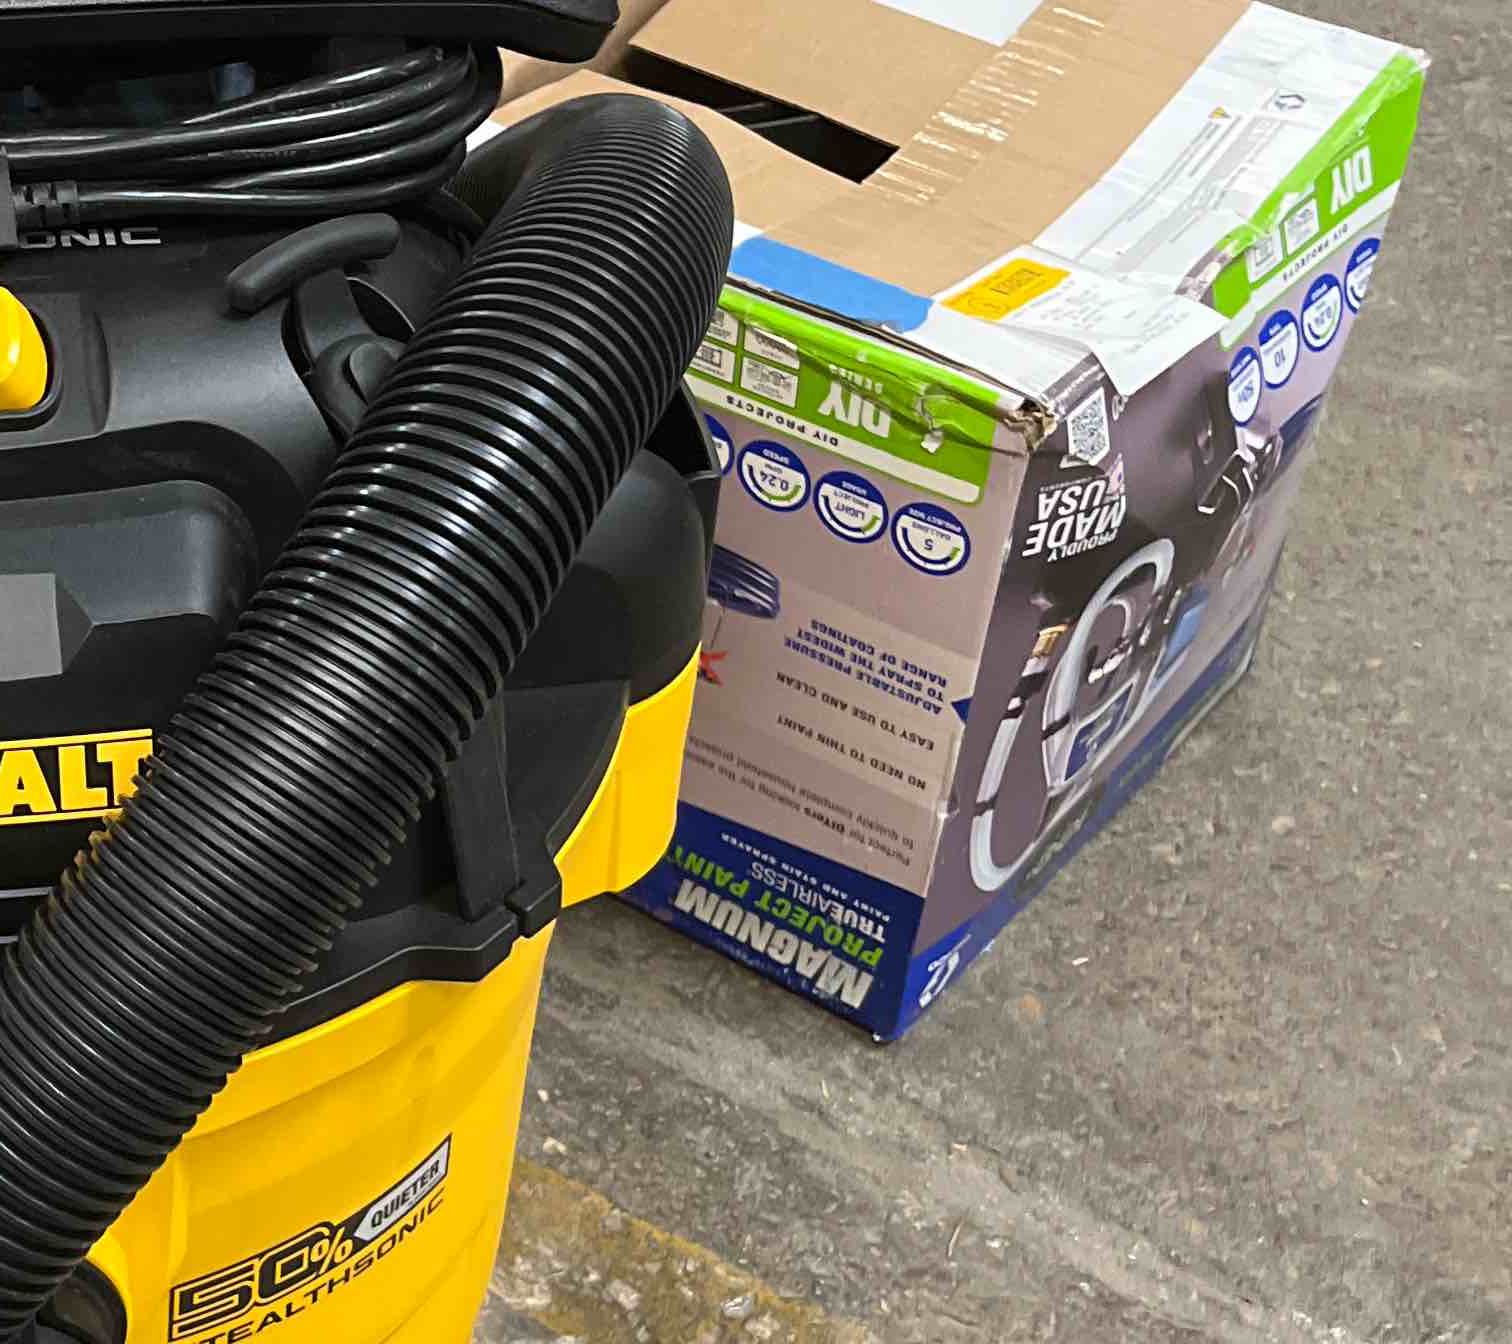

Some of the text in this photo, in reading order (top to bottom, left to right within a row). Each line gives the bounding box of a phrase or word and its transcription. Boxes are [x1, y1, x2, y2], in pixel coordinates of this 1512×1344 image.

[1330, 144, 1374, 215] DIY
[726, 395, 839, 448] DIY PROJECTS
[818, 379, 892, 439] DIY
[758, 469, 789, 491] 0.24
[762, 447, 789, 464] SPEED
[834, 500, 865, 520] LIGHT
[1022, 494, 1127, 557] MADE
[1038, 479, 1106, 523] USA
[919, 536, 933, 551] 5
[1047, 528, 1118, 563] PROUDLY
[783, 637, 941, 715] ADJUSTABLE PRESSURE
[795, 627, 944, 701] TO SPRAY THE WIDEST
[809, 618, 946, 687] RANGE OF COATINGS
[775, 671, 934, 751] EASY TO USE AND CLEAN
[775, 714, 926, 790] NO NEED TO THIN PAINT
[802, 806, 845, 834] DIYers
[671, 845, 883, 968] PROJECT PAINT
[721, 832, 890, 923] PAINT AND STAIN SPRAYER
[750, 861, 886, 943] TRUEAIRLESS
[674, 879, 874, 1009] MAGNUM
[171, 1160, 440, 1339] 50% QUIETER
